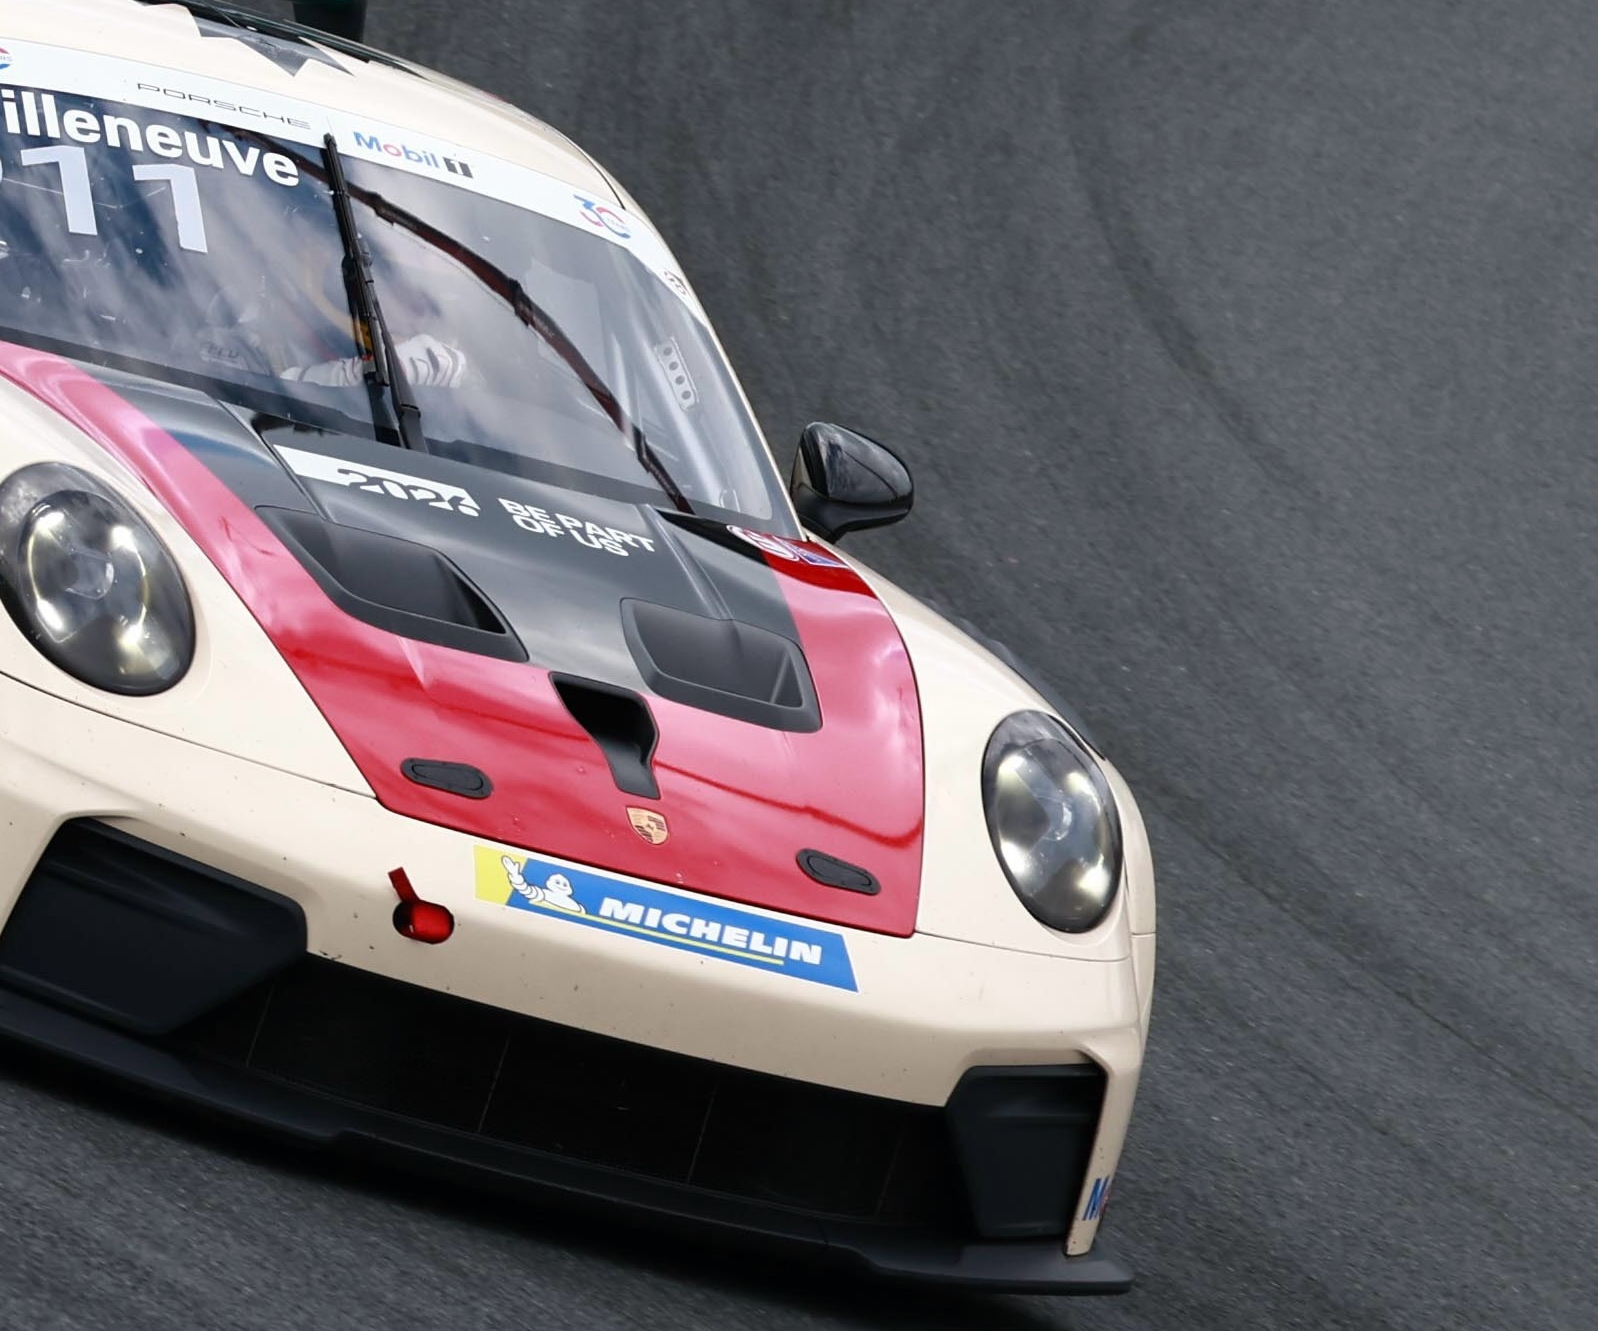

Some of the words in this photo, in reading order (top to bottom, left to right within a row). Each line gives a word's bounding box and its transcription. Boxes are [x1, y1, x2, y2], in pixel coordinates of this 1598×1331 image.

[137, 83, 311, 130] PORSCHE
[353, 131, 439, 169] Mobil
[497, 497, 550, 520] BE
[554, 512, 656, 553] PART
[512, 514, 565, 538] OF
[569, 529, 630, 557] US
[598, 897, 822, 966] MICHELIN
